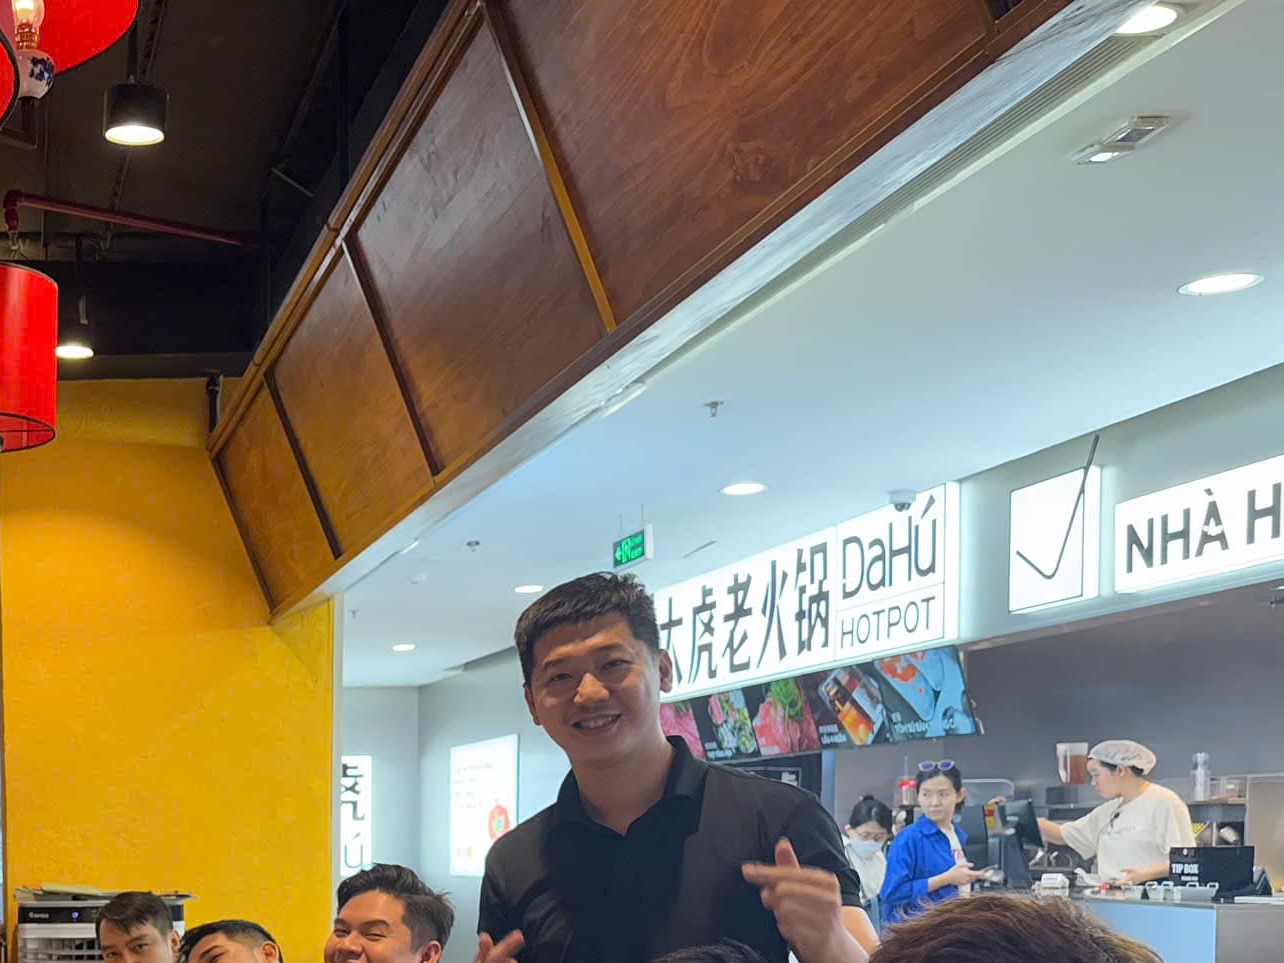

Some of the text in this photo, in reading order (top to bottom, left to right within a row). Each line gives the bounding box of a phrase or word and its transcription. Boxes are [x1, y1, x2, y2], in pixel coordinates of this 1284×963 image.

[843, 494, 936, 600] DaHú
[1126, 488, 1229, 574] NHÀ
[660, 540, 830, 684] 大虎老火锅
[841, 596, 935, 649] HOTPOT
[1171, 863, 1183, 874] TIP
